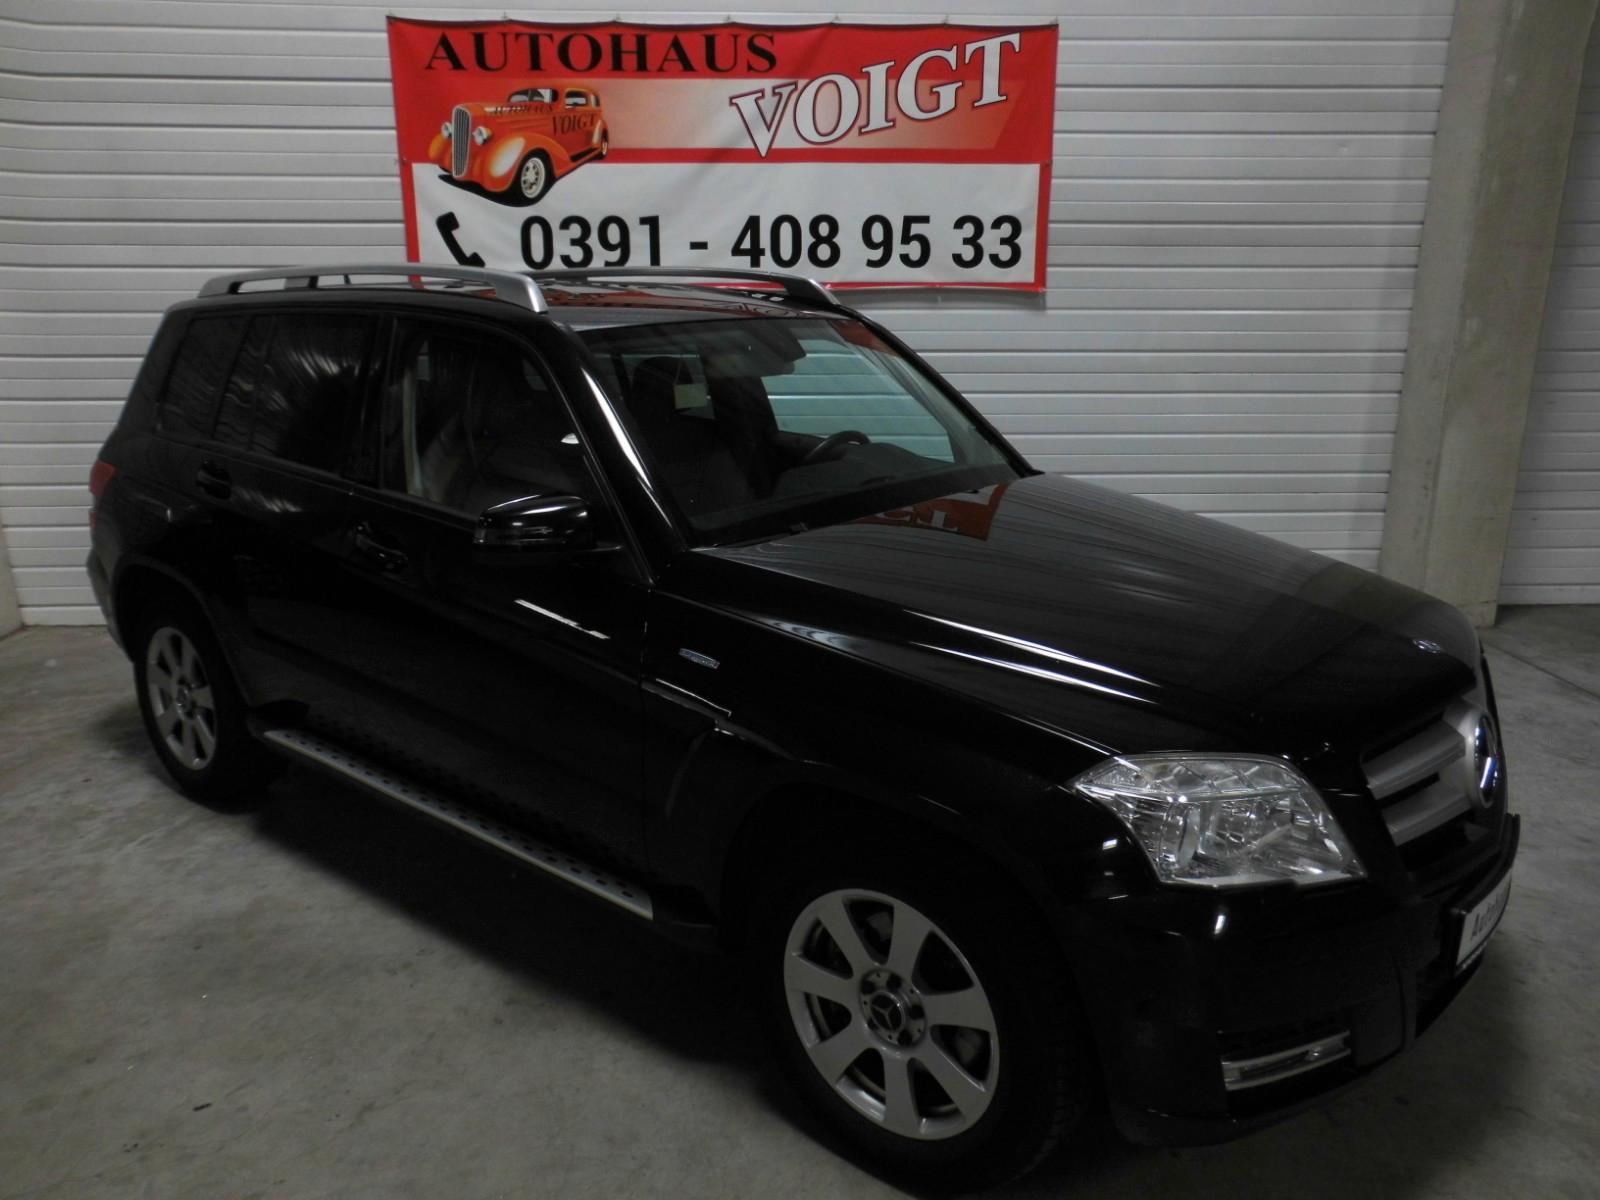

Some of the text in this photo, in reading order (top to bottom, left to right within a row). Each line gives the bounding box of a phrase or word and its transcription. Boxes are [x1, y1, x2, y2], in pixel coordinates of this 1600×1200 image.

[424, 31, 778, 74] AUTOHAUS
[729, 32, 1021, 158] VOIGT
[552, 112, 598, 136] VOIGT
[520, 214, 661, 270] 0391
[731, 214, 842, 269] 408
[861, 214, 932, 270] 95
[951, 214, 1023, 269] 33
